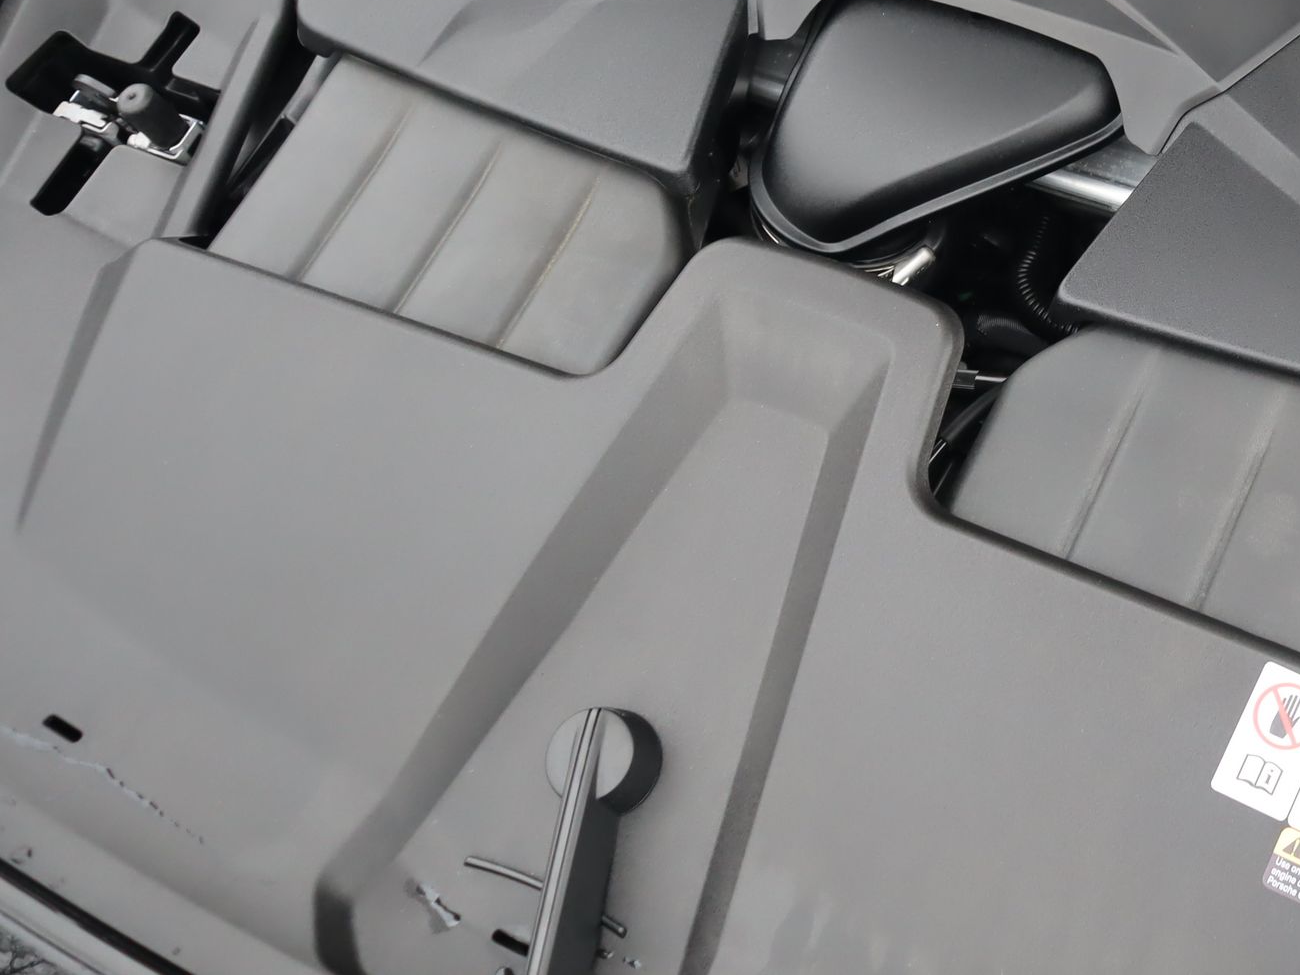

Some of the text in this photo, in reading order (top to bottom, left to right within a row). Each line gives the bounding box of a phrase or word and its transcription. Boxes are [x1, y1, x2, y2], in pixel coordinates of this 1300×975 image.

[1275, 856, 1290, 870] Use
[1271, 867, 1297, 885] engine
[1267, 875, 1298, 897] Porsche
